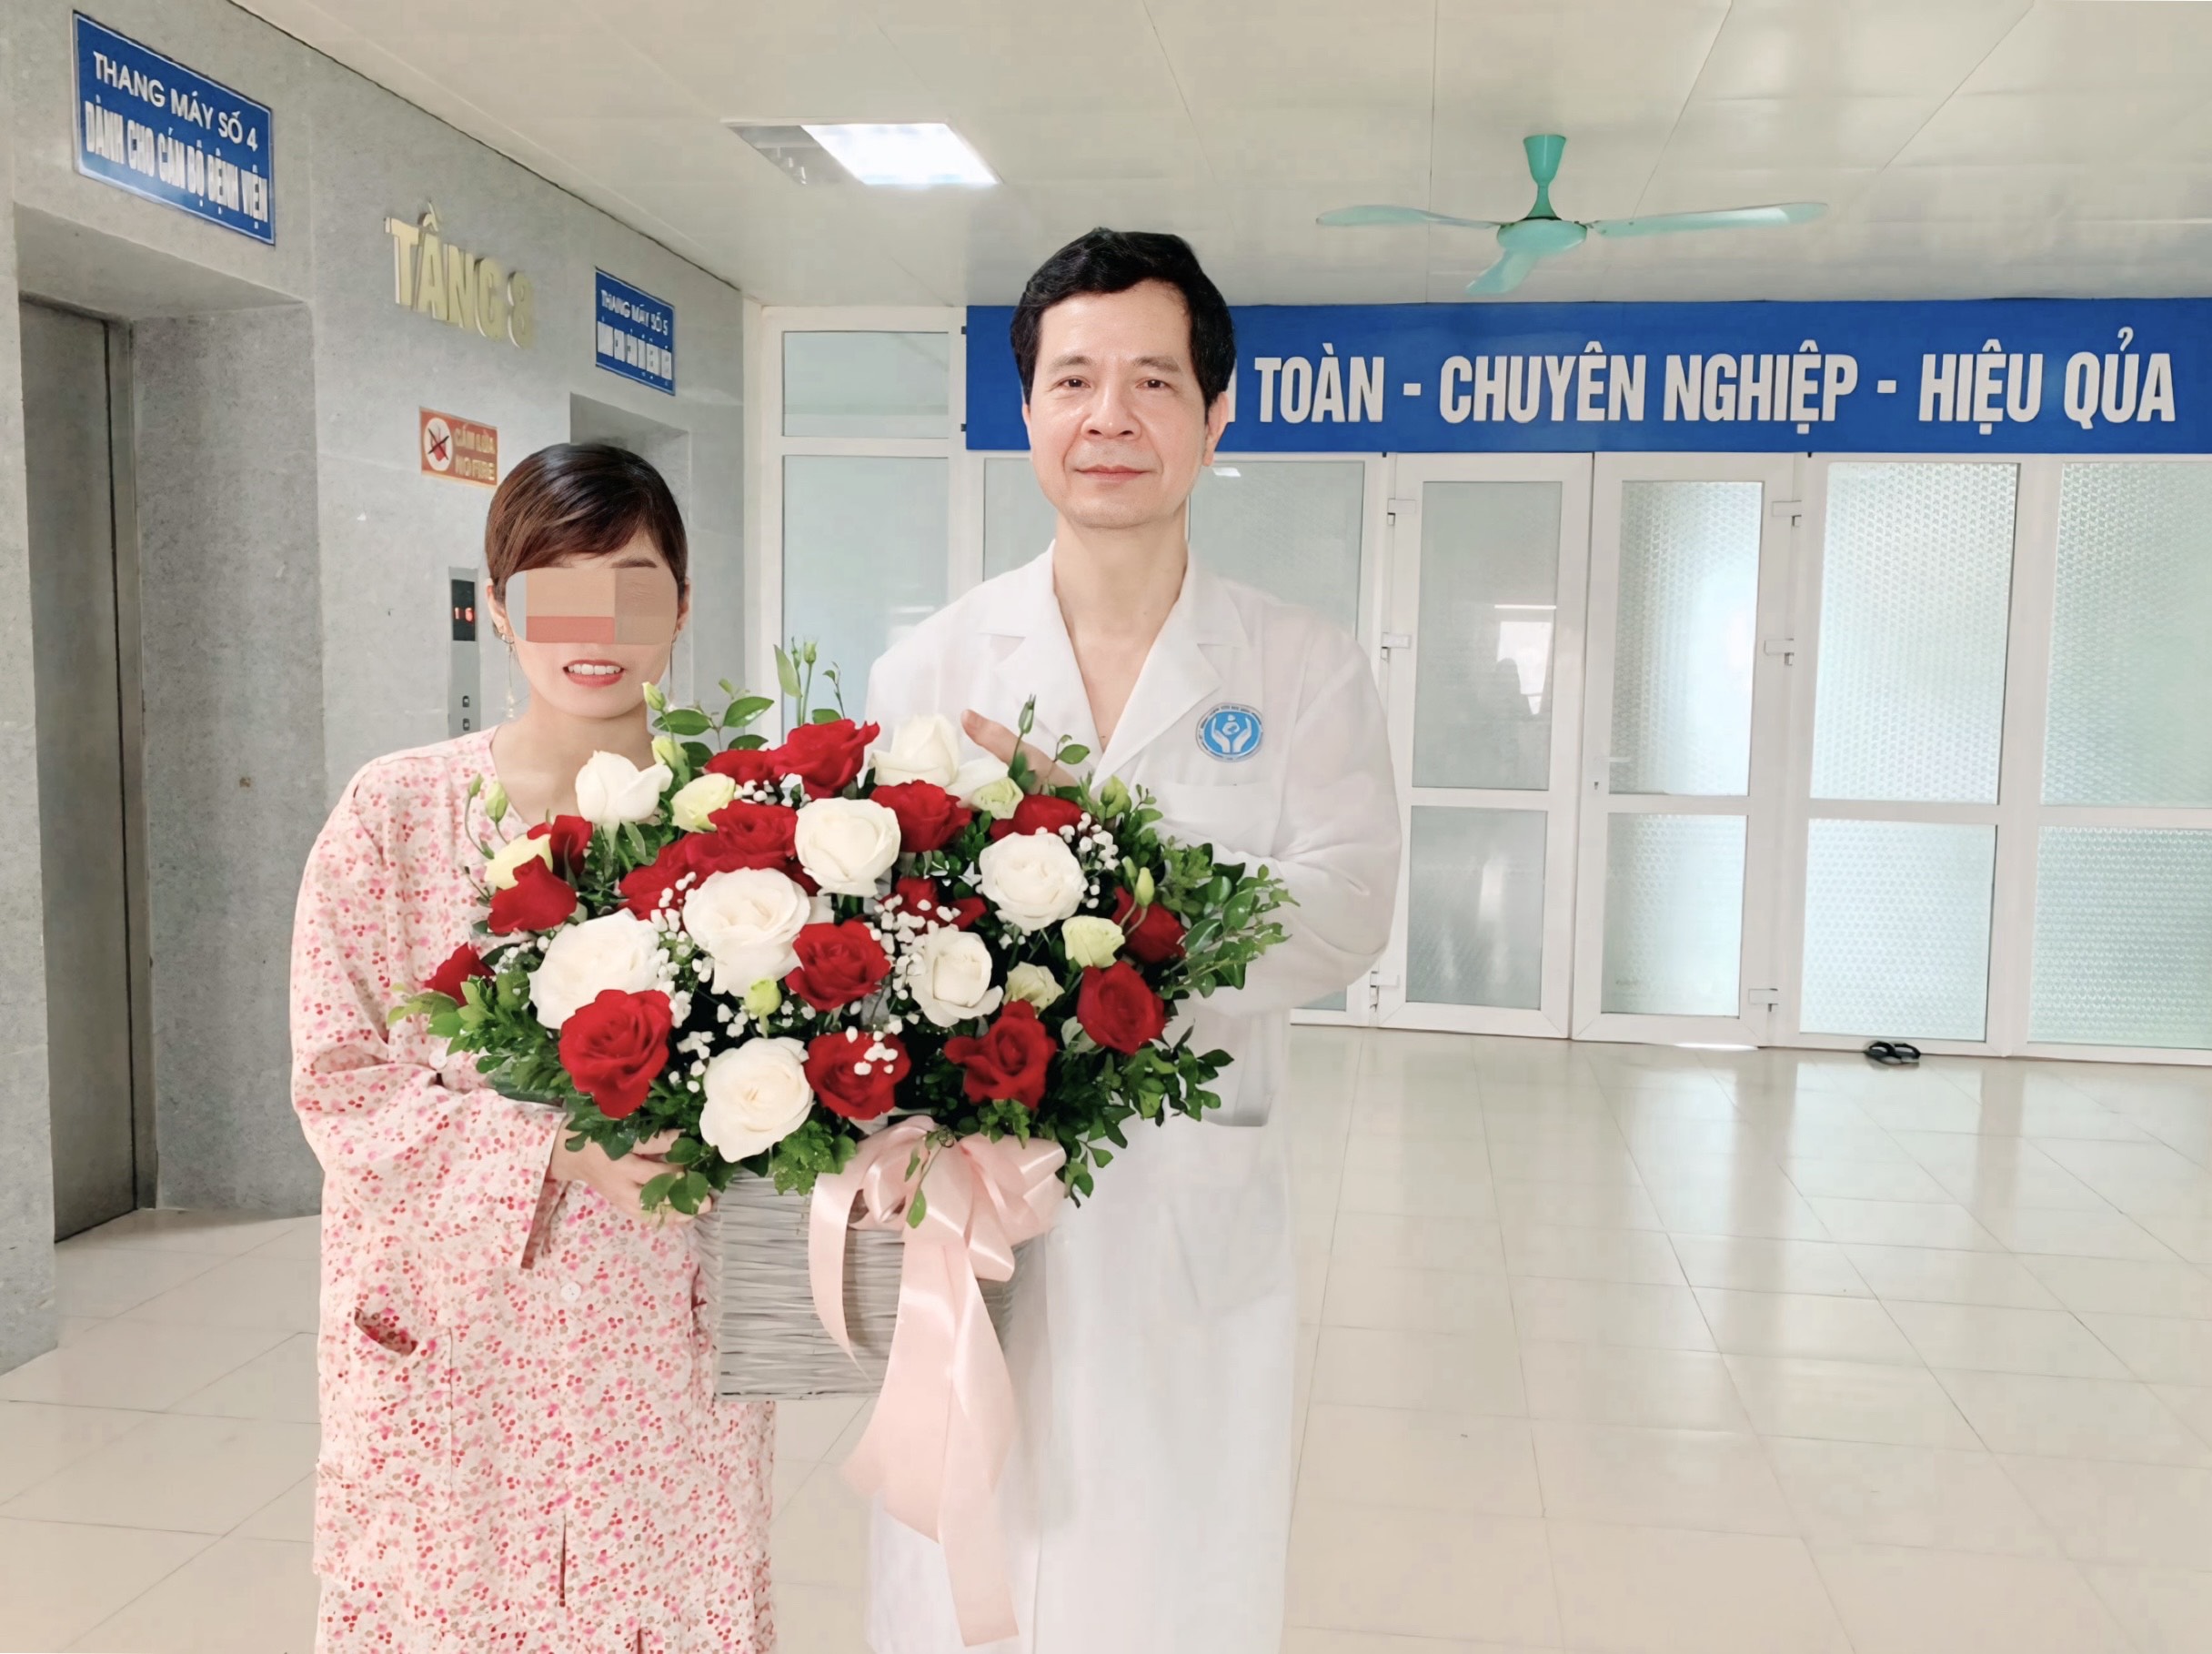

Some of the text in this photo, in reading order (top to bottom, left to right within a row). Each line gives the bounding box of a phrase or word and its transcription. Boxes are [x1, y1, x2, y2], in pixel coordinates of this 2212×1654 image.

[93, 51, 258, 152] THANG MÁY SỐ 4
[85, 95, 268, 229] DÀNH CHO CÁN BỘ BỆNH VIỆN
[384, 201, 533, 348] TẦNG 8
[600, 289, 631, 318] THANG
[651, 312, 663, 332] SỐ
[663, 320, 669, 336] 5
[1254, 342, 1384, 423] TOÀN
[1440, 340, 1646, 422] CHUYÊN
[1663, 339, 1858, 435] NGHIỆP
[1918, 338, 2044, 435] HIỆU
[2063, 327, 2176, 429] QỦA
